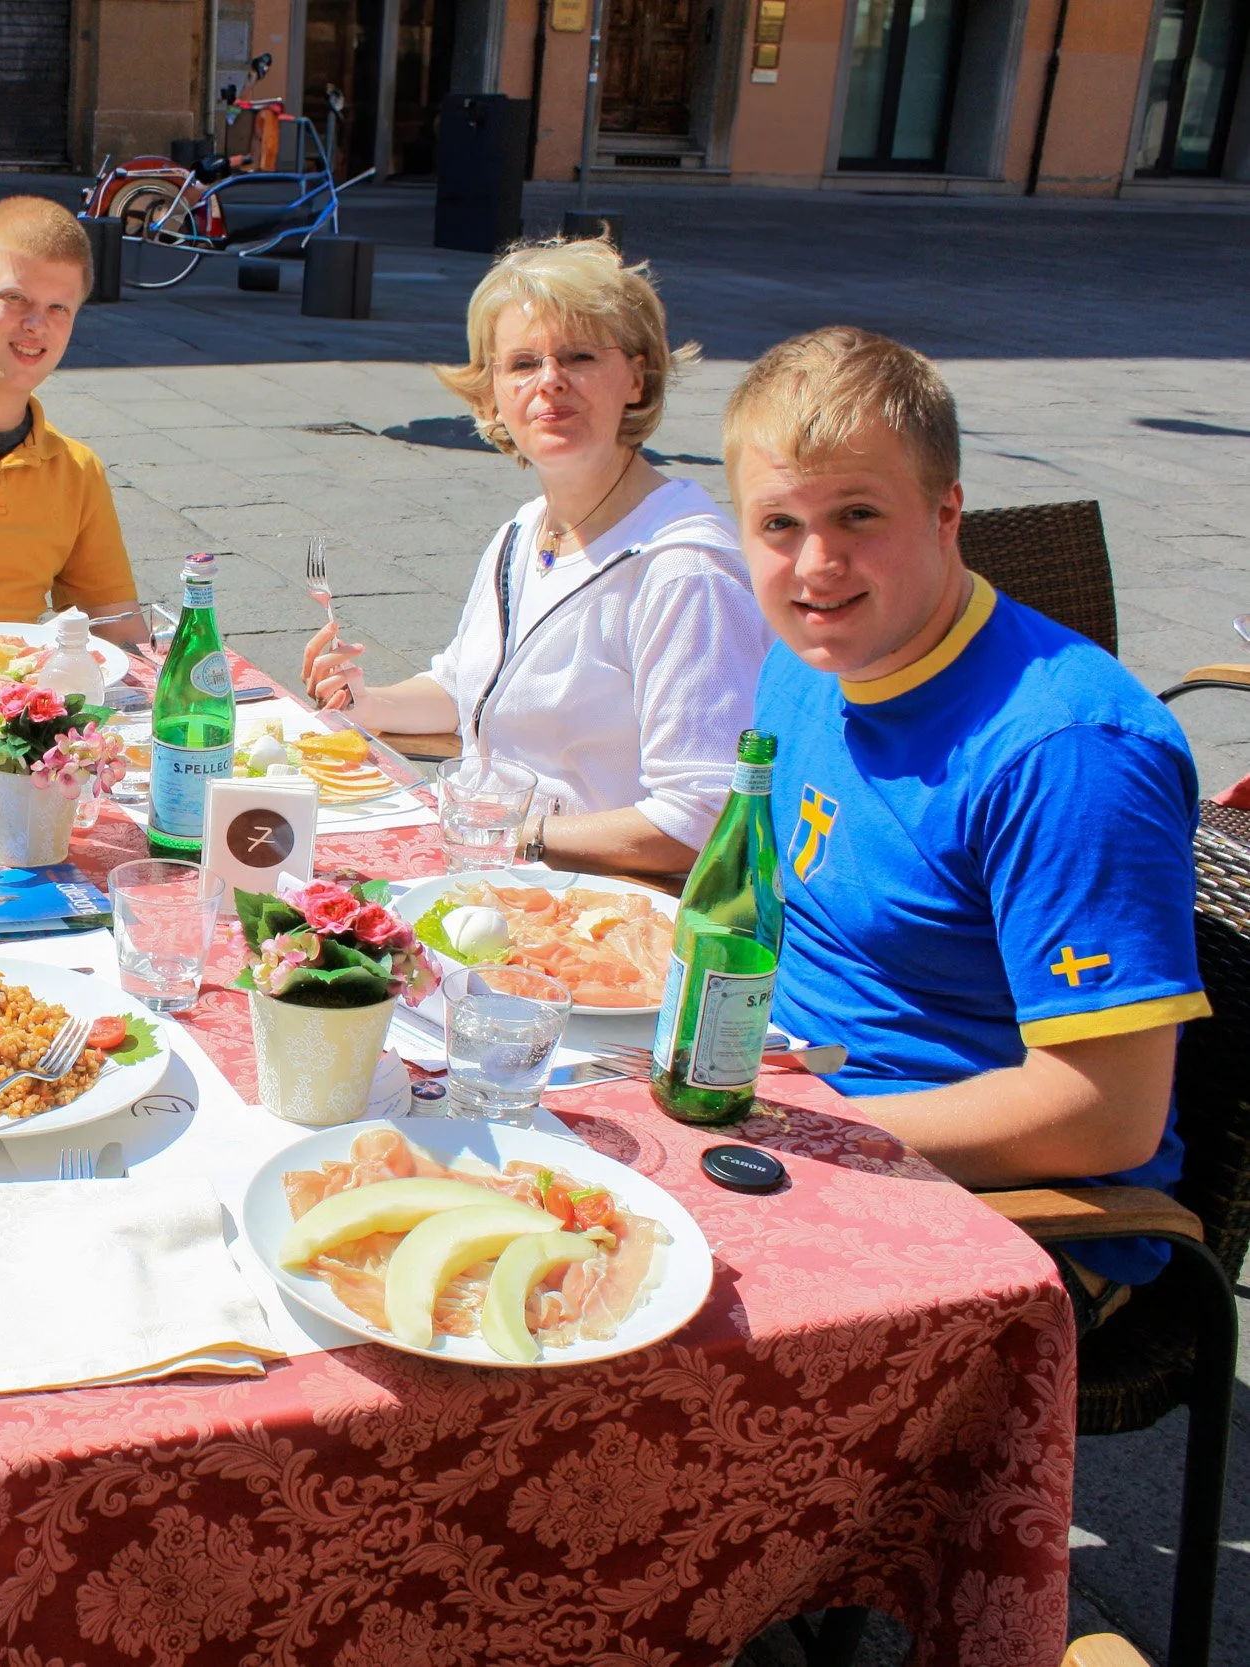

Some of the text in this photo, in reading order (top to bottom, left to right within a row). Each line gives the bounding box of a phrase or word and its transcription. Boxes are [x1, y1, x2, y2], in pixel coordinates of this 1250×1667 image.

[247, 826, 275, 852] 7
[746, 988, 773, 1006] S.PE
[720, 1155, 767, 1172] Canon
